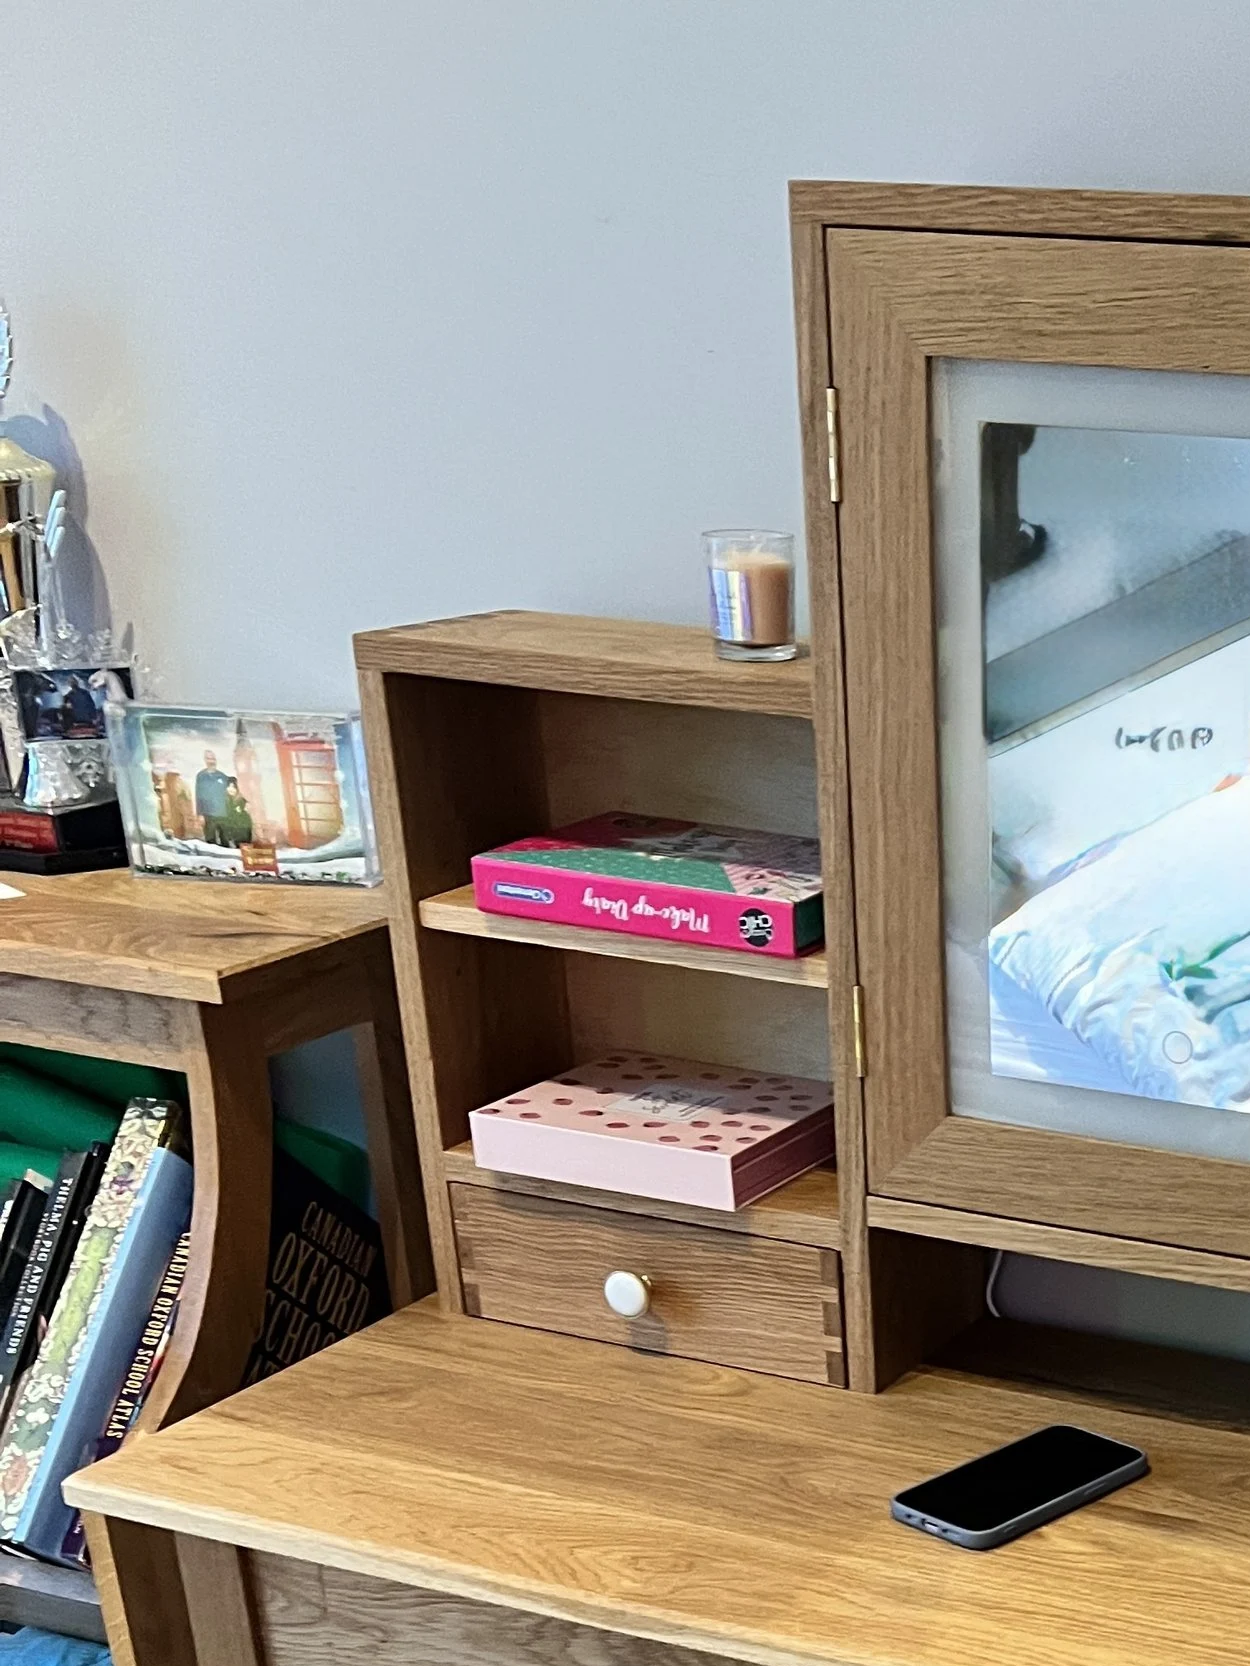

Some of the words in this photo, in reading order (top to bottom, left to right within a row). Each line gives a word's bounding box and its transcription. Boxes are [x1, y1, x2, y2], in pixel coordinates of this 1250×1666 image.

[581, 886, 630, 922] Diary
[631, 895, 710, 933] Make-up
[44, 1178, 74, 1236] THELMA,
[301, 1201, 378, 1278] CANADIAN
[26, 1265, 44, 1294] AND
[272, 1231, 370, 1334] OXFORD
[5, 1298, 34, 1355] FRIENDS
[142, 1298, 174, 1346] OXFORD
[122, 1348, 154, 1395] SCHOOL
[106, 1400, 135, 1439] ATLAS
